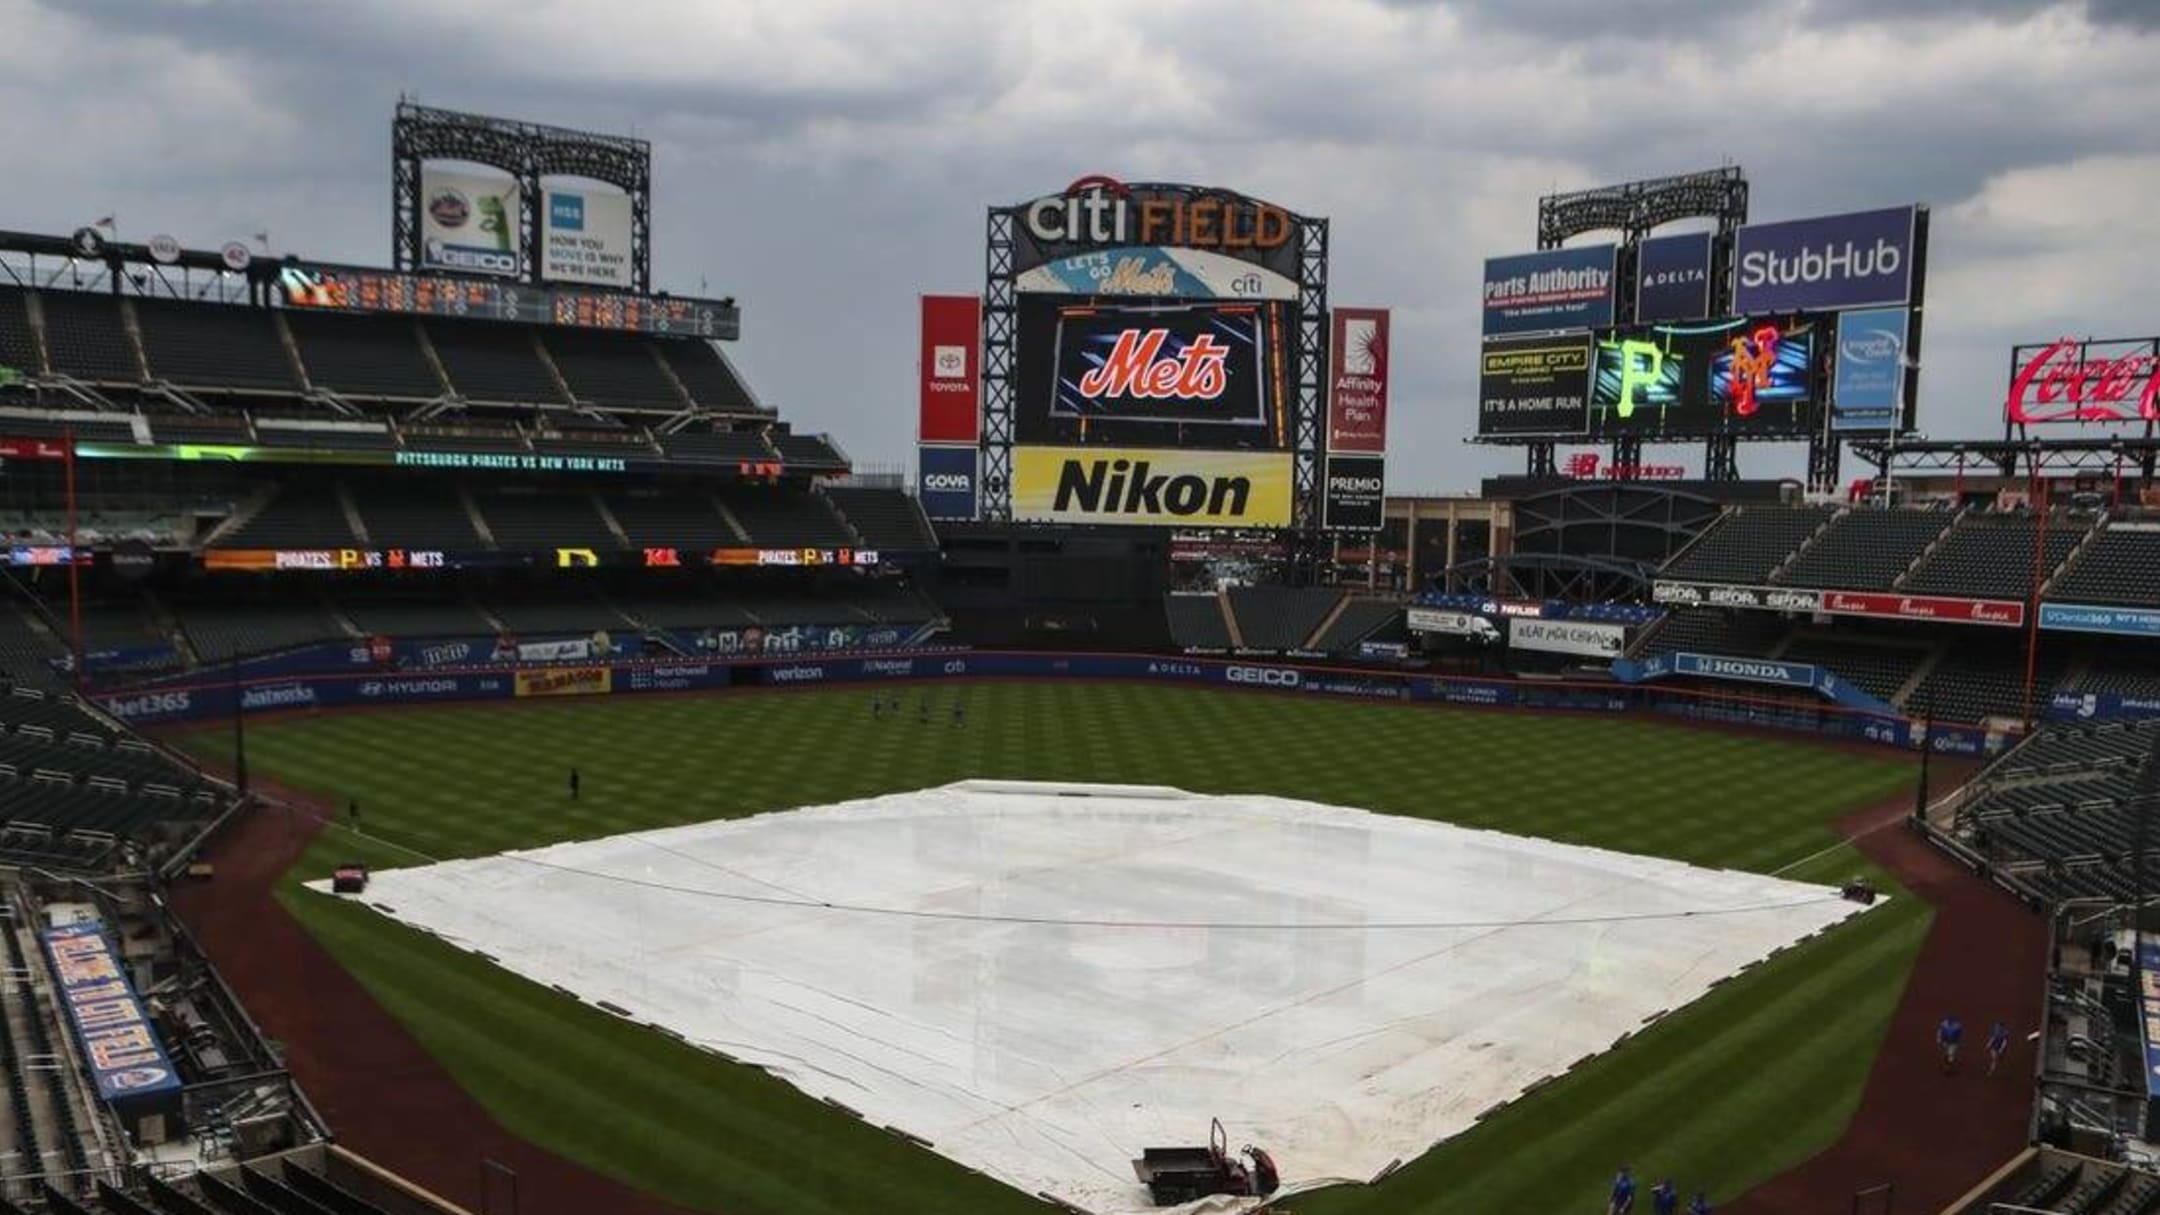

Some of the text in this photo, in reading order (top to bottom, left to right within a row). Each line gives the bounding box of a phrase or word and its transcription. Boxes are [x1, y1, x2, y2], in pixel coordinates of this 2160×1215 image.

[1028, 188, 1290, 247] citi FIELD
[551, 236, 604, 251] HOW YOU
[441, 249, 515, 271] GEICO
[599, 252, 625, 265] WHY
[1065, 254, 1110, 271] LET'S
[1741, 238, 1900, 288] StubHub
[1231, 275, 1262, 294] citi
[1485, 266, 1610, 299] Parts Authority
[1657, 269, 1705, 285] DELTA
[1080, 329, 1231, 399] Mets
[1488, 351, 1582, 369] EMPIRE CITY
[930, 382, 970, 393] TOYOTA
[1336, 376, 1383, 395] Affinity
[1338, 392, 1379, 408] Health
[1485, 396, 1582, 412] IT'S A HOME RUN
[1345, 408, 1371, 422] Plan
[395, 451, 626, 472] PITTSBURGH PIRATES VS NEW YORK METS
[925, 474, 971, 488] GOYA
[1053, 459, 1251, 517] Nikon
[1330, 476, 1382, 491] PREMIO
[275, 551, 331, 569] PIRATES
[364, 551, 383, 567] VS
[409, 551, 445, 567] METS
[758, 550, 798, 564] PIRATES
[821, 551, 834, 563] VS
[853, 551, 878, 564] METS
[653, 665, 708, 676] Northwell
[772, 665, 824, 681] verizon
[1160, 663, 1202, 675] DELTA
[1225, 665, 1299, 685] GEICO
[1714, 660, 1790, 679] HONDA
[387, 680, 457, 694] HYUNDAI
[109, 692, 191, 717] bet365
